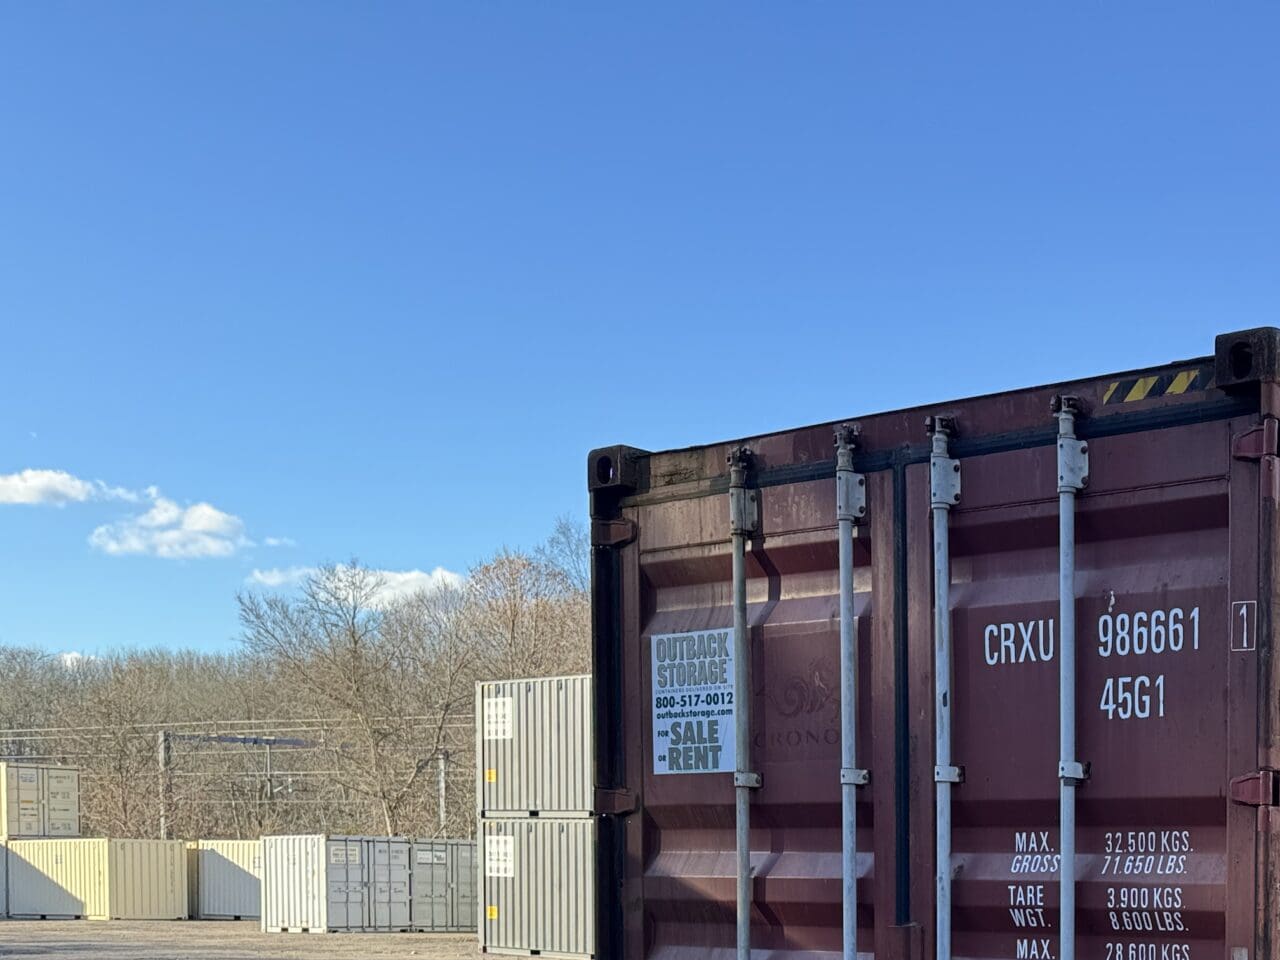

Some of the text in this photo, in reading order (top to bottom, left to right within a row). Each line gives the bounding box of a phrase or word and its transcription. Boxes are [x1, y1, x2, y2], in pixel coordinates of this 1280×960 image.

[656, 632, 729, 663] OUTBACK
[984, 618, 1054, 666] CRXU
[1098, 606, 1200, 657] 986661
[657, 658, 728, 689] STORAGE
[656, 692, 734, 709] 800-517-0012
[1099, 675, 1165, 720] 45G1
[656, 708, 733, 719] outbackstorage.com
[657, 720, 720, 746] FOR SALE
[658, 745, 722, 771] OR RENT
[1015, 831, 1194, 853] MAX. 32.500 KGS.
[1011, 854, 1188, 875] GROSS 71.650 LBS.
[1008, 885, 1186, 909] TARE 3.900 KGS.
[1009, 908, 1189, 932] WGT. 8.600 LBS.
[1016, 939, 1055, 960] MAX.
